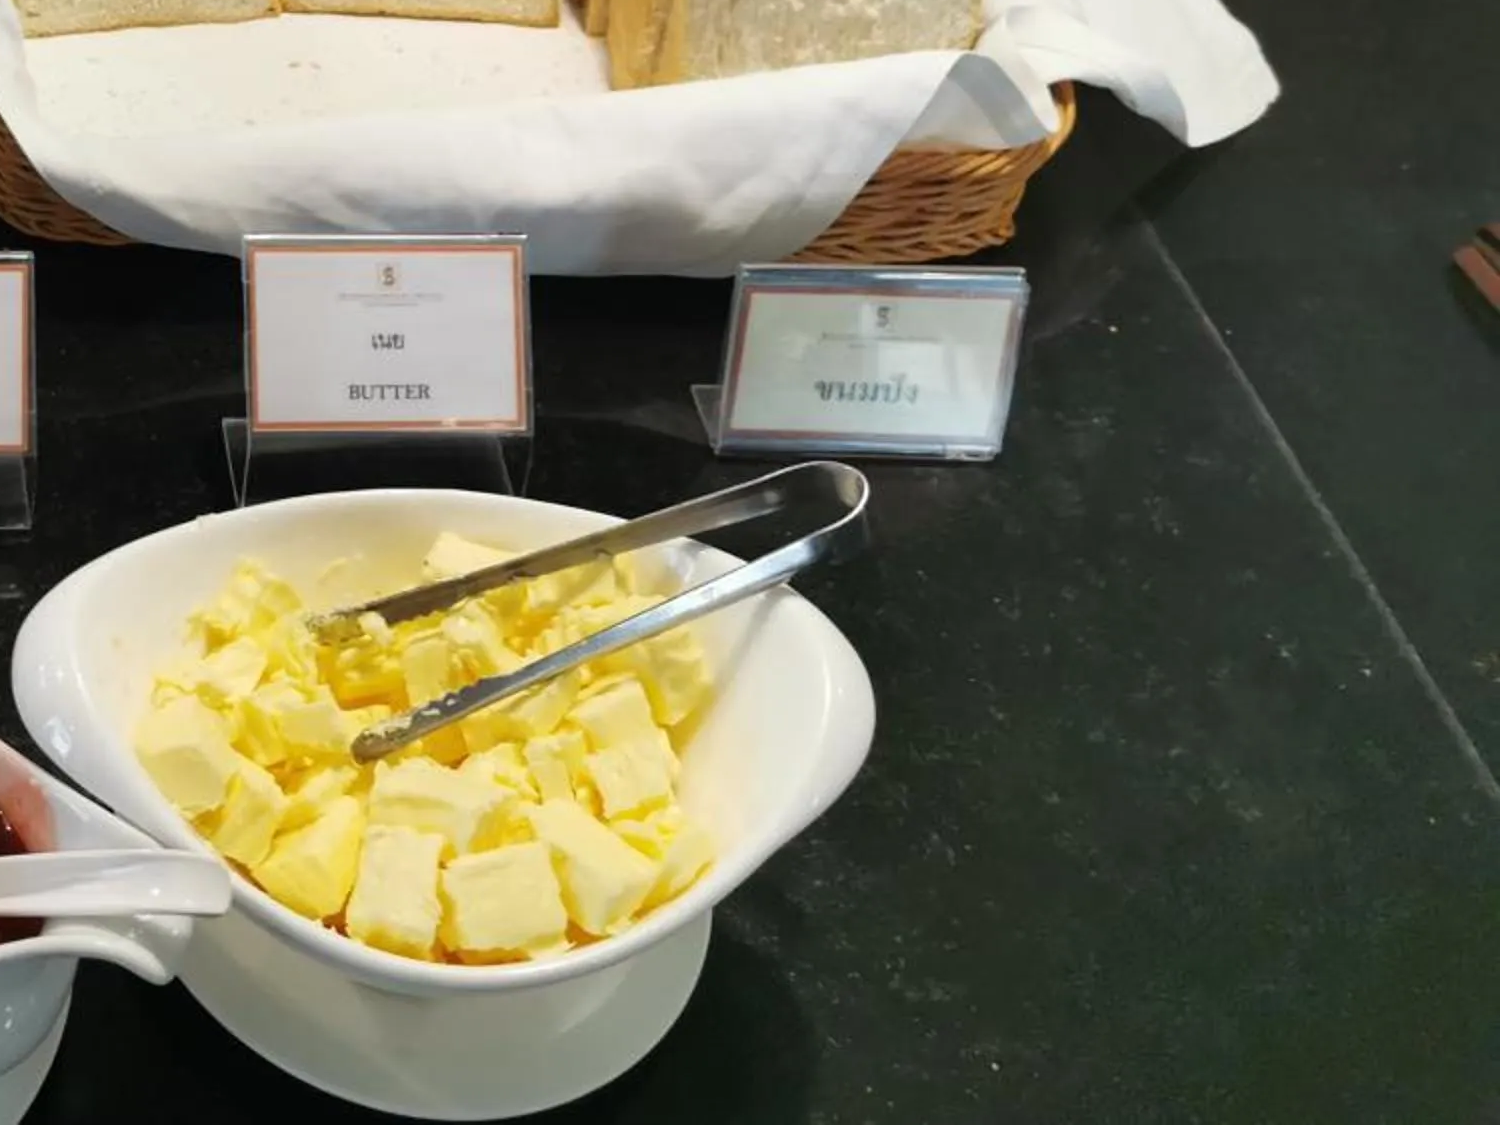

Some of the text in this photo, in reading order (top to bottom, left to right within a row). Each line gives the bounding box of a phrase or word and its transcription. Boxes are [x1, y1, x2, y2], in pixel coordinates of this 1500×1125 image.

[371, 333, 405, 351] เนย
[348, 383, 432, 401] BUTTER
[813, 372, 920, 404] ขนมปัง
